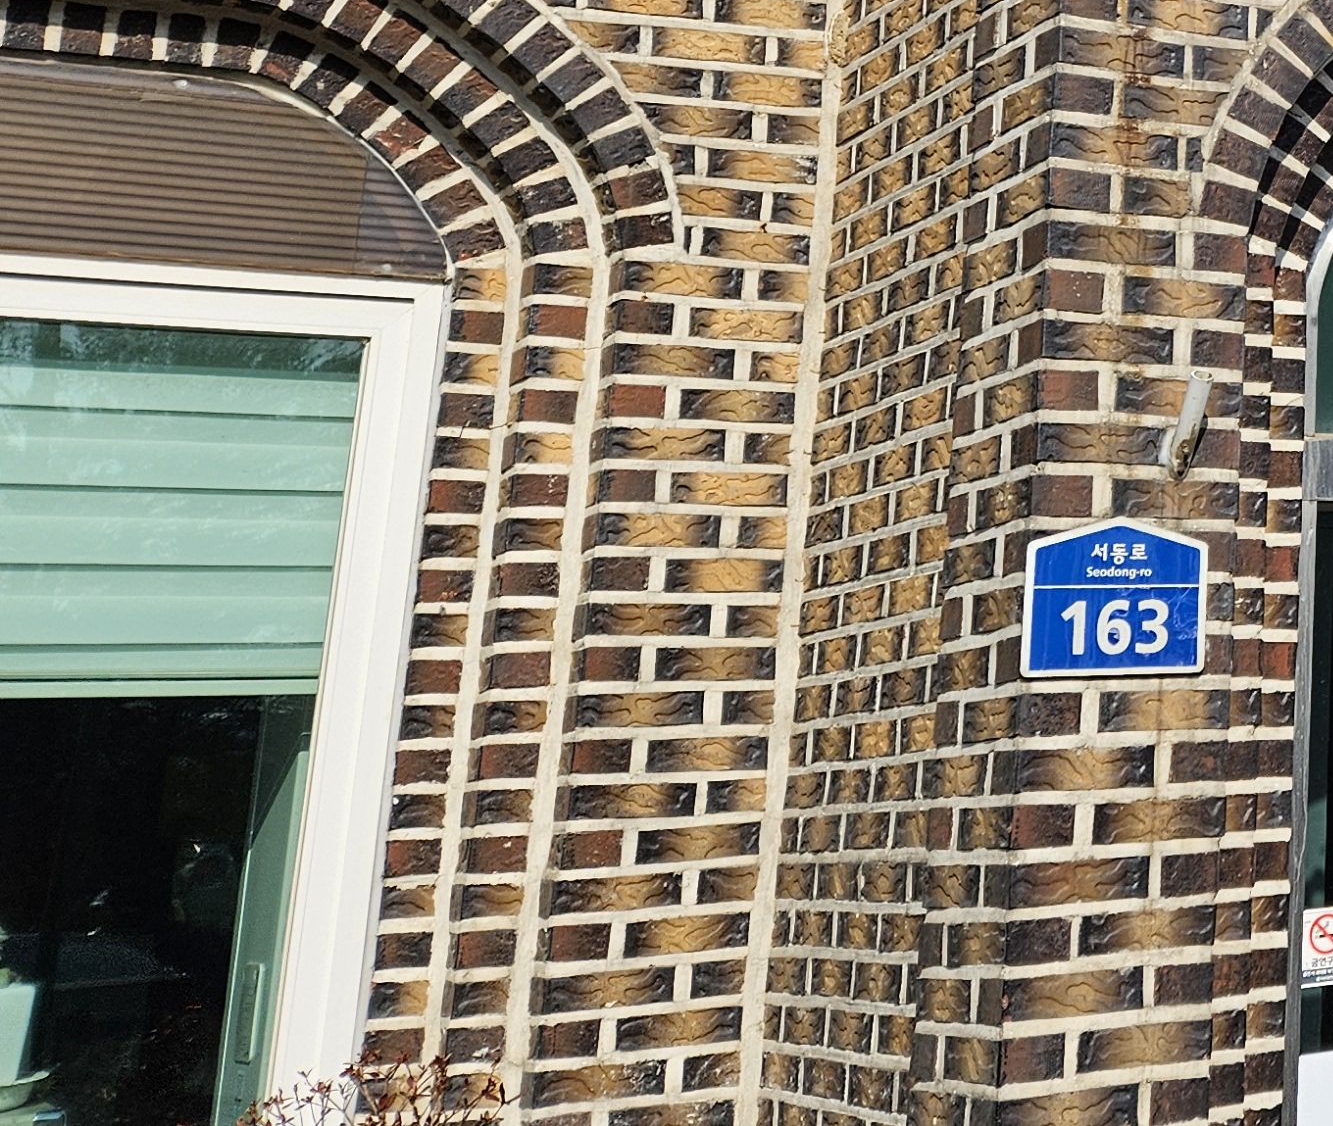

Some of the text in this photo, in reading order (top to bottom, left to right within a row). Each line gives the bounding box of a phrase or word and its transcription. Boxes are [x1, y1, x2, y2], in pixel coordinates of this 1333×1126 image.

[1091, 543, 1148, 565] 서동로
[1086, 566, 1152, 580] Seodong-ro
[1060, 599, 1169, 656] 163
